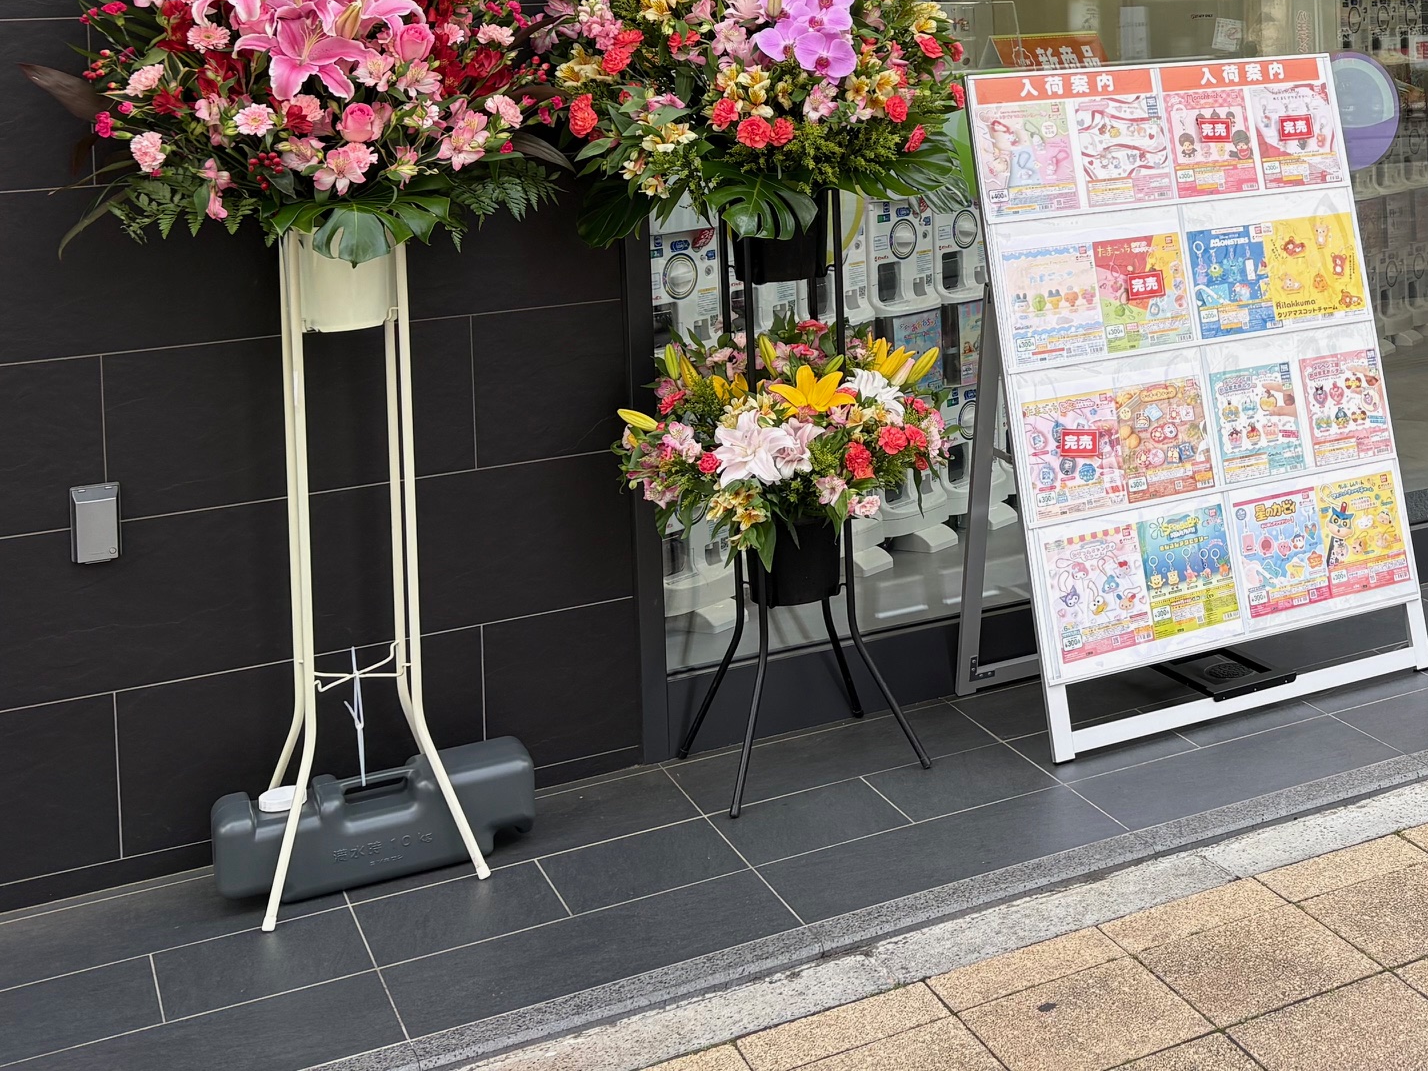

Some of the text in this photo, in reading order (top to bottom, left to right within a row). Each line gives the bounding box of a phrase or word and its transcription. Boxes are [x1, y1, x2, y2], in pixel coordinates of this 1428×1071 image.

[1036, 45, 1101, 70] 新商品
[1200, 62, 1285, 86] 入荷案内
[1020, 73, 1115, 97] 入荷案内
[1201, 123, 1227, 136] 完売
[1283, 120, 1307, 134] 完売
[1097, 242, 1131, 257] たまごっち
[1131, 276, 1159, 293] 完売
[1276, 299, 1316, 310] Rilakkuma
[1064, 434, 1093, 449] 完売
[1254, 498, 1297, 522] 星のカービィ
